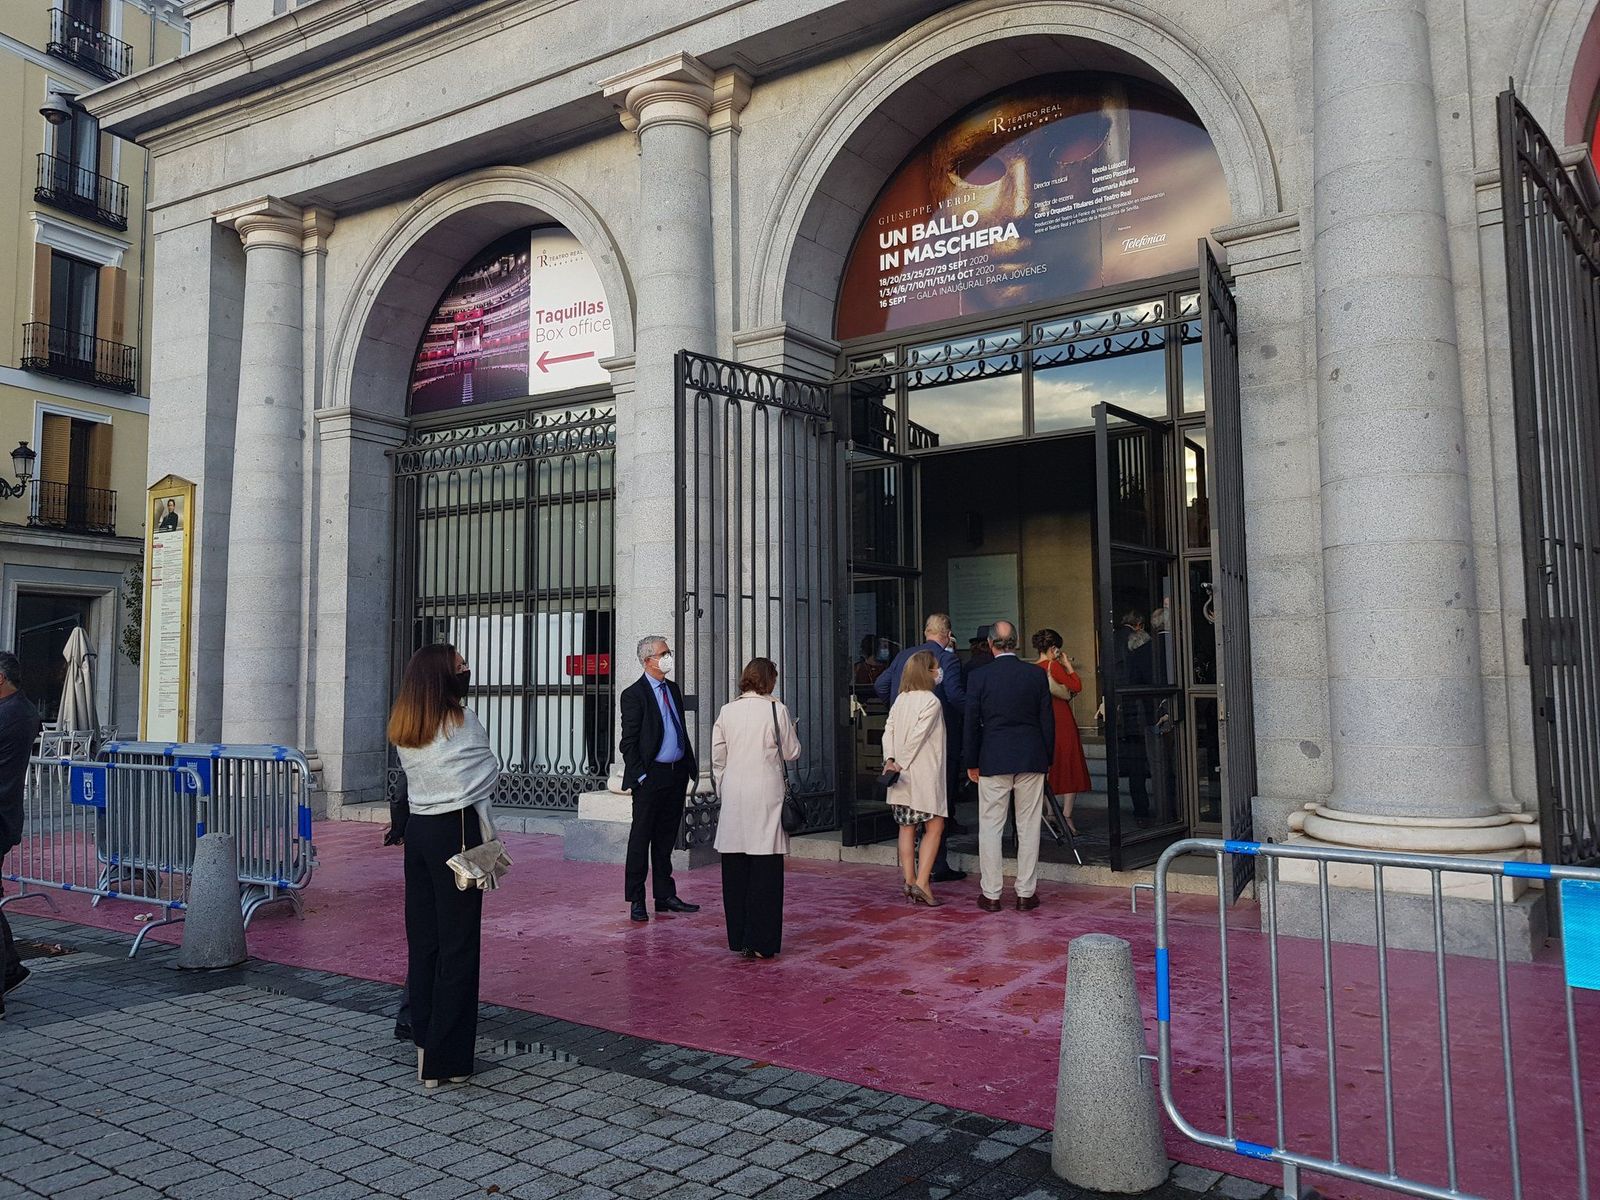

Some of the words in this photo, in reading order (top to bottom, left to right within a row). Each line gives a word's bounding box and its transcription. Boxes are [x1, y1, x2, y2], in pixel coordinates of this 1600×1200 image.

[1008, 110, 1038, 124] TEATRO
[1040, 103, 1061, 115] REAL
[1034, 180, 1050, 190] Director
[1051, 175, 1068, 185] musical
[1091, 165, 1107, 175] Nicola
[1091, 173, 1112, 184] Lorenzo
[1112, 165, 1136, 178] Passerini
[1092, 182, 1118, 194] Gianmaria
[878, 204, 932, 226] GIUSEPPE
[938, 192, 977, 210] VERDI
[1034, 200, 1051, 209] Director
[1058, 194, 1074, 203] escena
[1050, 205, 1073, 215] Orquesta
[1073, 199, 1094, 209] Titulares
[1094, 196, 1103, 204] del
[1103, 193, 1120, 202] Teatro
[1120, 189, 1132, 198] Real
[879, 226, 907, 249] UN
[911, 209, 979, 242] BALLO
[549, 252, 569, 262] TEATRO
[879, 251, 899, 272] IN
[904, 222, 1020, 266] MASCHERA
[879, 264, 947, 287] 18/20/23/25/27/29
[948, 258, 968, 272] SEPT
[969, 254, 989, 266] 2020
[879, 272, 956, 298] 1/3/4/6/7/10/11/13/14
[957, 269, 974, 281] OCT
[975, 264, 995, 277] 2020
[879, 299, 888, 309] 16
[888, 295, 907, 307] SEPT
[916, 289, 938, 301] GALA
[939, 279, 984, 296] INAUGURAL
[985, 273, 1008, 286] PARA
[535, 300, 604, 325] Taquillas
[536, 327, 564, 343] Box
[568, 318, 611, 337] office
